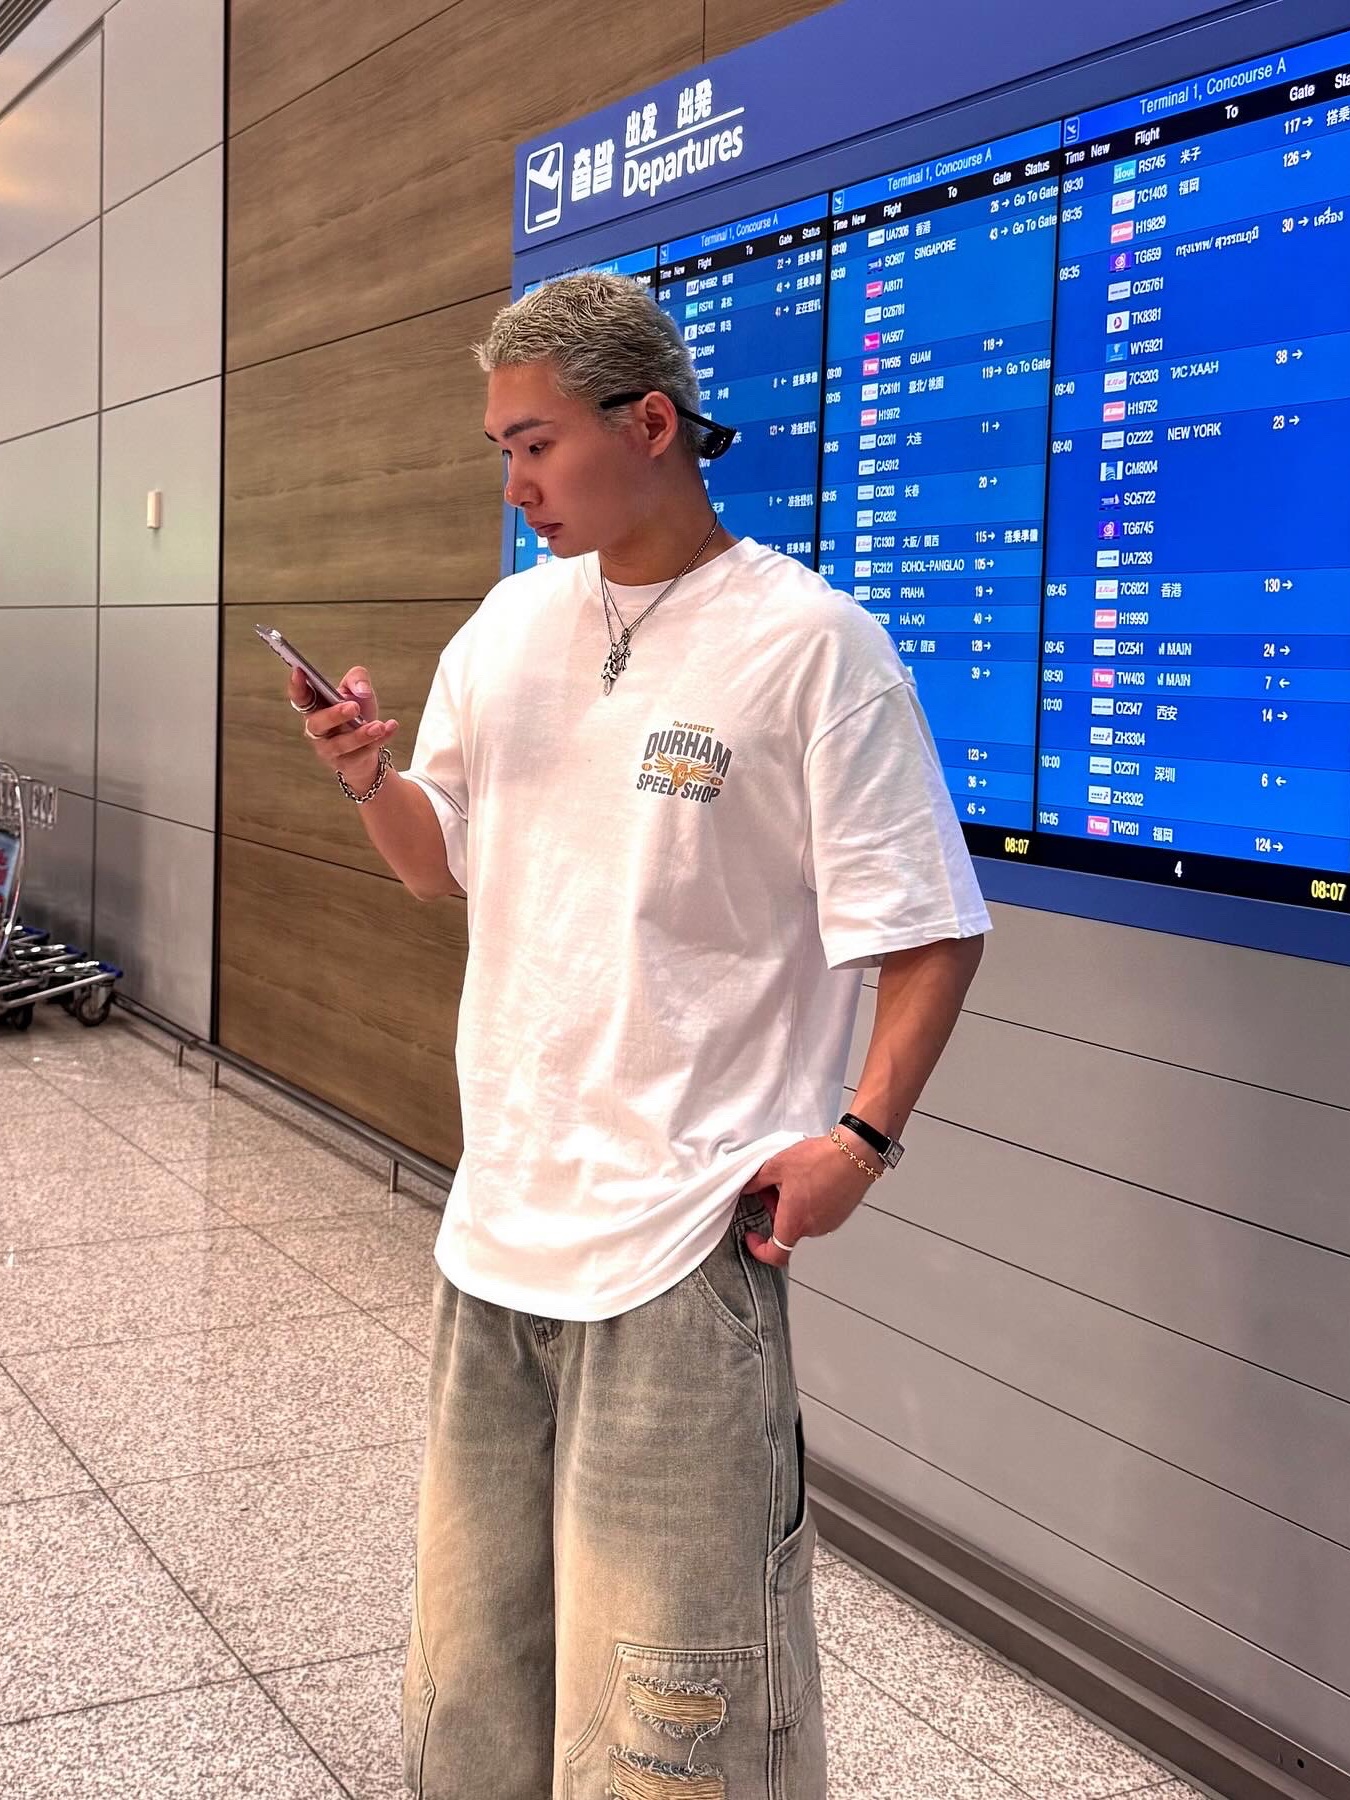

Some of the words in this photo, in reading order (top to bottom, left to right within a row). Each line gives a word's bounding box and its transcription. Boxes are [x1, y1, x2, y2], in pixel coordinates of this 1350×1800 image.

[1140, 87, 1189, 115] Terminal
[1193, 84, 1202, 101] 1,
[1206, 62, 1273, 95] Concourse
[1276, 57, 1286, 74] A
[625, 102, 657, 149] 出发
[677, 78, 713, 129] 出発
[1065, 150, 1085, 165] Time
[1091, 143, 1111, 159] New
[1134, 127, 1160, 146] Flight
[1225, 105, 1239, 120] To
[1289, 84, 1315, 101] Gate
[623, 125, 743, 197] Departures
[1063, 177, 1084, 194] 09:30
[1138, 155, 1166, 174] RS745
[1180, 147, 1201, 165] 米子
[1284, 118, 1301, 135] 117
[571, 139, 615, 201] 출발
[888, 173, 923, 192] Terminal
[925, 167, 932, 181] 1,
[935, 154, 982, 177] Concourse
[985, 148, 992, 162] A
[833, 219, 848, 232] Time
[851, 213, 867, 227] New
[883, 202, 901, 219] Flight
[947, 186, 958, 199] To
[993, 171, 1011, 186] Gate
[1025, 160, 1050, 177] Status
[1014, 193, 1026, 207] Go
[1027, 191, 1038, 203] To
[1039, 186, 1059, 201] Gate
[1062, 206, 1083, 223] 09:35
[1137, 185, 1167, 204] 7C1403
[1179, 177, 1200, 196] 福岡
[1282, 150, 1299, 167] 126
[701, 232, 728, 248] Terminal
[736, 219, 771, 237] Concourse
[772, 214, 779, 225] A
[914, 238, 957, 260] SINGAPORE
[1012, 221, 1024, 235] Go
[1025, 218, 1036, 231] To
[1037, 214, 1058, 228] Gate
[660, 268, 672, 280] Time
[697, 257, 712, 270] Flight
[746, 245, 754, 256] To
[779, 234, 793, 247] Gate
[802, 226, 821, 240] Status
[1060, 265, 1080, 281] 09:35
[1134, 247, 1162, 265] TG659
[1282, 217, 1294, 234] 30
[1133, 278, 1164, 295] OZ6761
[1131, 308, 1161, 325] TK8381
[1131, 338, 1163, 355] WY5921
[910, 351, 932, 365] GUAM
[1006, 363, 1018, 375] Go
[1019, 361, 1030, 373] To
[1031, 357, 1051, 371] Gate
[1054, 382, 1075, 396] 09:40
[1129, 368, 1159, 385] 7C5203
[1275, 350, 1287, 364] 38
[906, 432, 923, 447] 大连
[982, 421, 989, 433] 11
[1052, 440, 1072, 454] 09:40
[1126, 431, 1153, 445] OZ222
[1168, 426, 1190, 441] NEW
[1192, 422, 1221, 439] YORK
[1273, 415, 1285, 429] 23
[1125, 461, 1158, 475] CM8004
[979, 477, 988, 489] 20
[1124, 491, 1156, 506] SQ5722
[975, 531, 988, 543] 115
[1123, 521, 1154, 536] TG6745
[902, 560, 965, 573] BOHOL-PANGLAO
[974, 559, 986, 571] 105
[1122, 551, 1153, 565] UA7293
[901, 588, 925, 599] PRAHA
[975, 586, 984, 597] 19
[1046, 584, 1067, 597] 09:45
[1120, 582, 1149, 595] 7C6021
[1161, 583, 1182, 598] 香港
[1264, 579, 1280, 593] 130
[1044, 641, 1065, 654] 09:45
[1118, 642, 1144, 655] OZ541
[1167, 643, 1192, 656] MAIN
[1263, 644, 1275, 657] 24
[971, 668, 980, 679] 39
[1043, 670, 1063, 683] 09:50
[1117, 673, 1145, 686] TW403
[1166, 674, 1191, 687] MAIN
[1265, 676, 1272, 689] 7
[1043, 699, 1062, 711] 10:00
[1116, 702, 1142, 715] OZ347
[1156, 706, 1178, 721] 西安
[1262, 709, 1273, 722] 14
[684, 723, 715, 734] FASTEST
[1114, 732, 1146, 746] ZH3304
[644, 730, 733, 778] DURHAM
[1041, 756, 1060, 769] 10:00
[1114, 762, 1140, 776] OZ371
[1154, 766, 1176, 782] 深圳
[1262, 774, 1268, 788] 6
[636, 773, 679, 796] SPEED
[681, 782, 721, 803] SHOP
[1112, 793, 1144, 807] ZH3302
[1039, 812, 1059, 826] 10:05
[1112, 821, 1139, 836] TW201
[1152, 827, 1173, 843] 福岡
[1255, 838, 1271, 852] 124
[1005, 837, 1029, 854] 08:07
[1175, 861, 1182, 878] 4
[1311, 880, 1347, 901] 08:07
